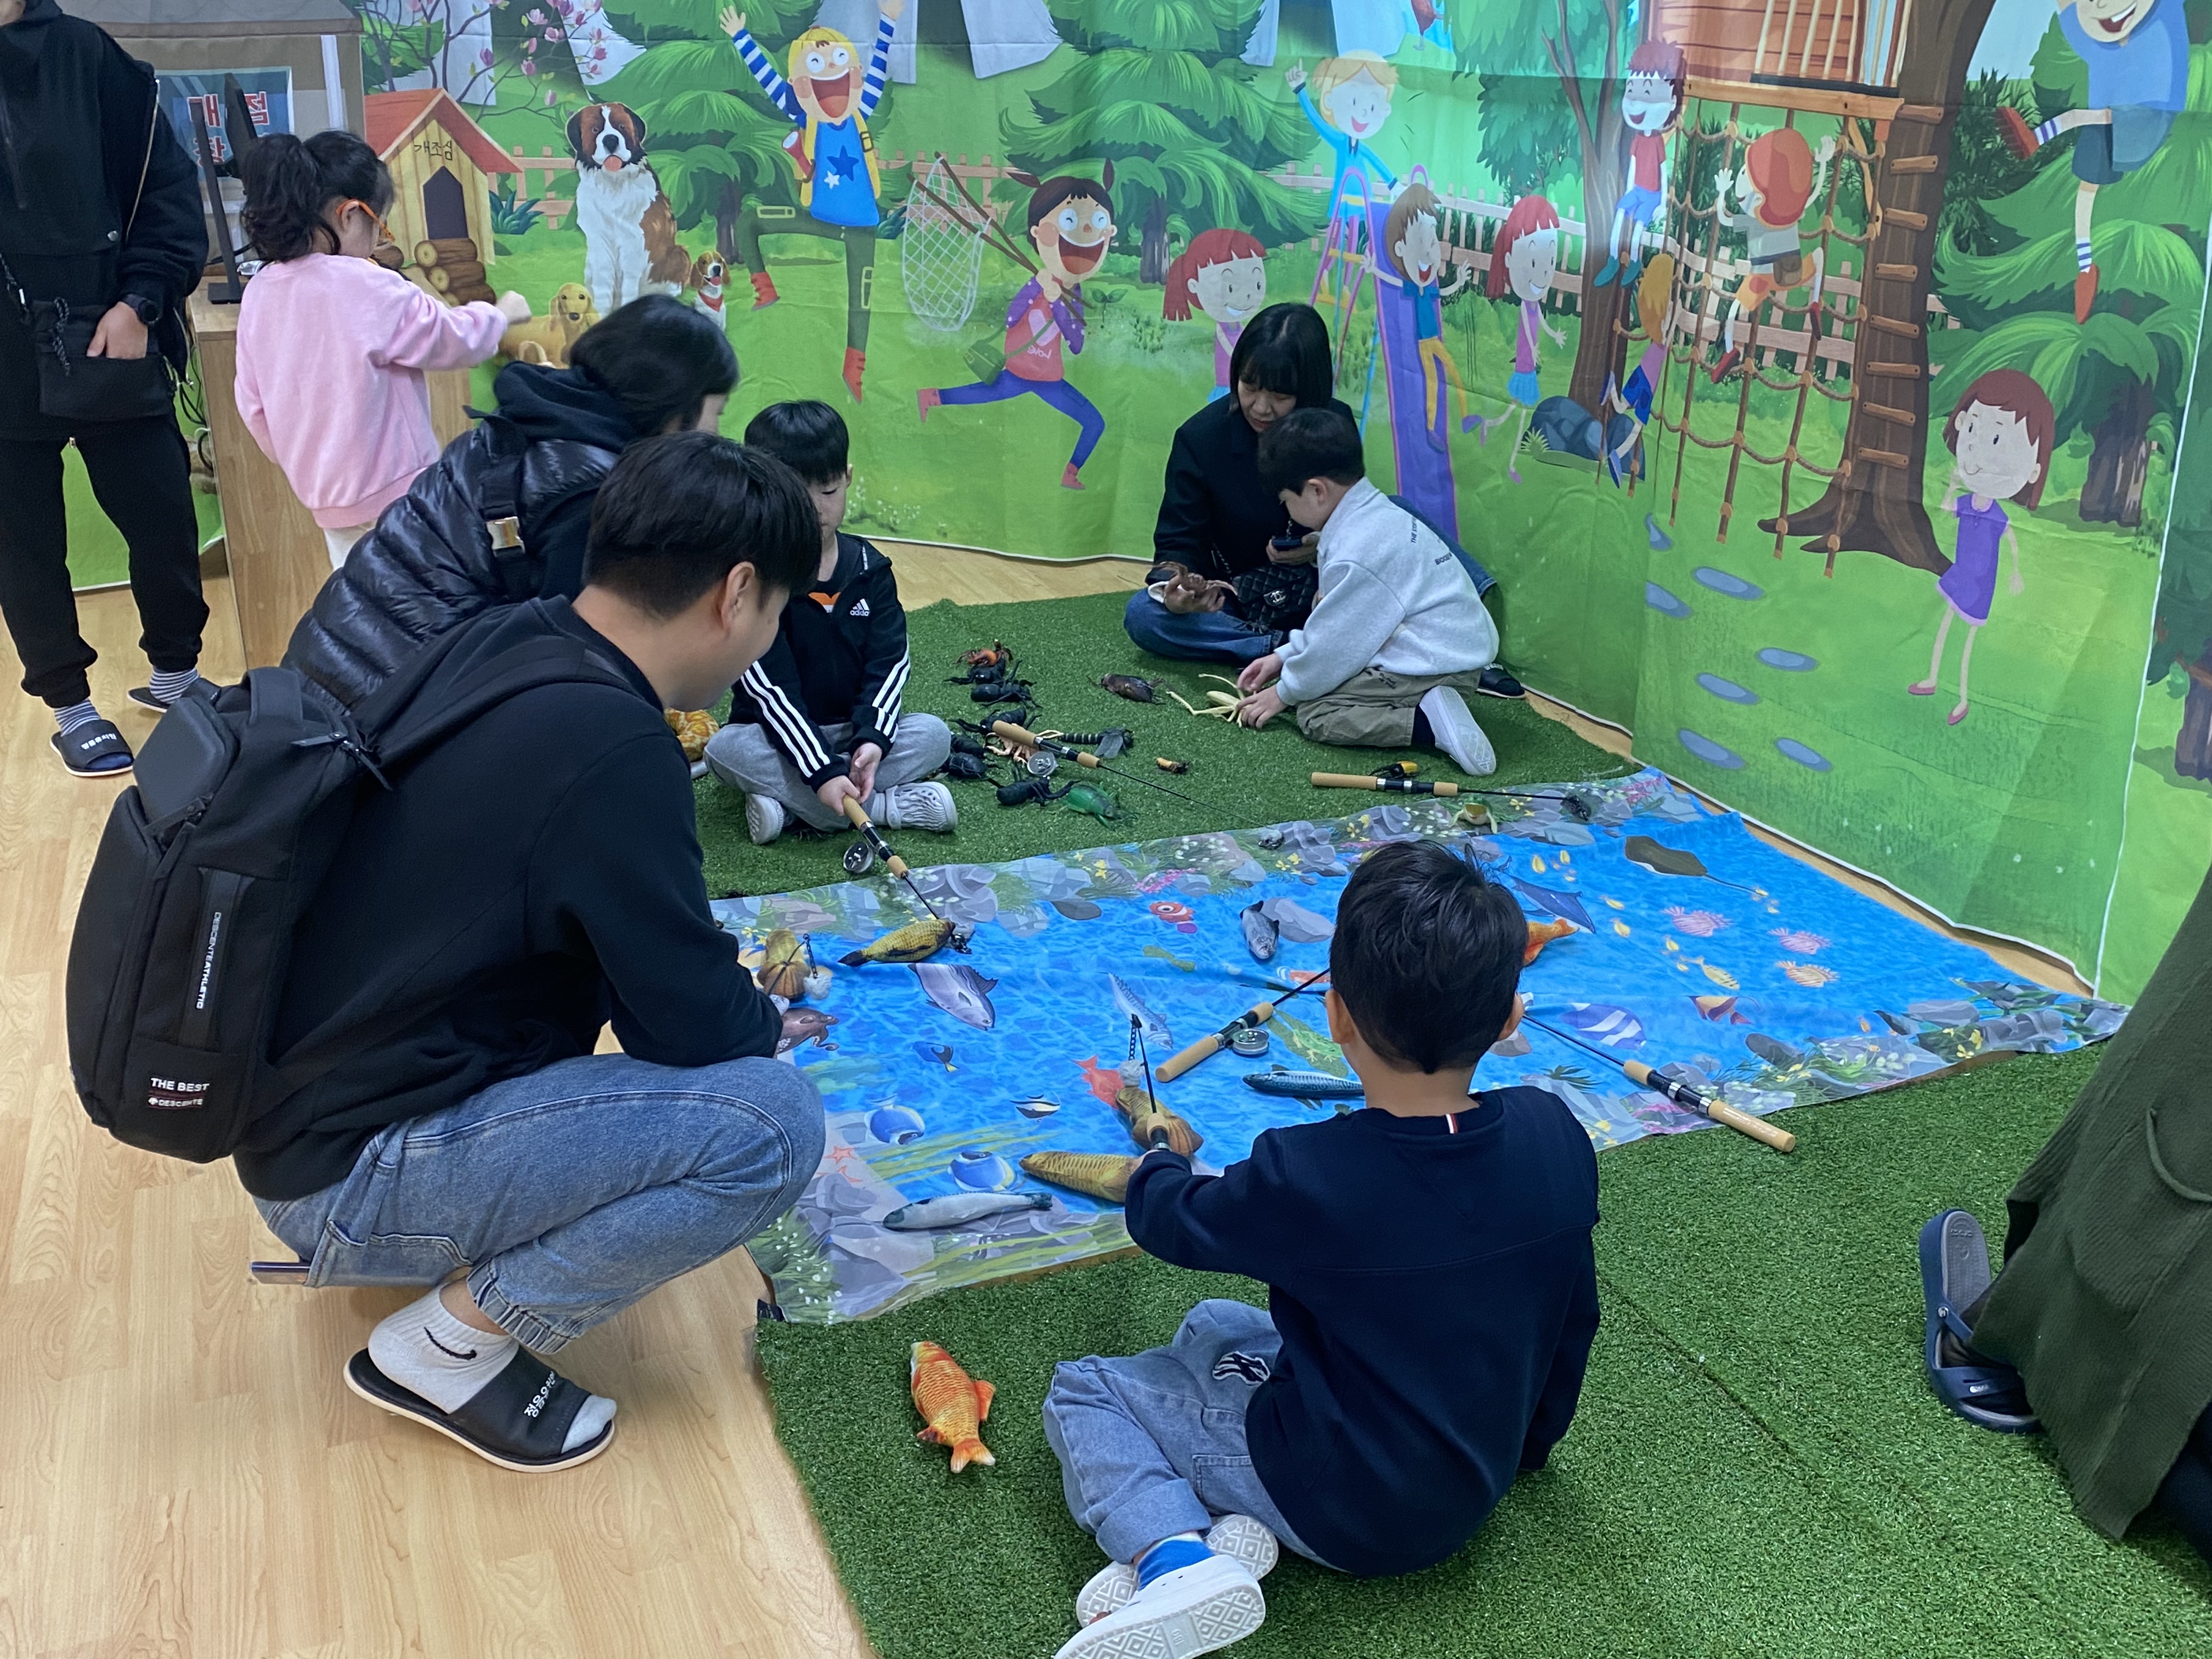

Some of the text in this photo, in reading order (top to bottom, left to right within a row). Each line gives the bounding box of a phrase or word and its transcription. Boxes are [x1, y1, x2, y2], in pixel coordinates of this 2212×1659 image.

[414, 140, 453, 161] 개조심
[150, 1077, 210, 1092] THE BEST
